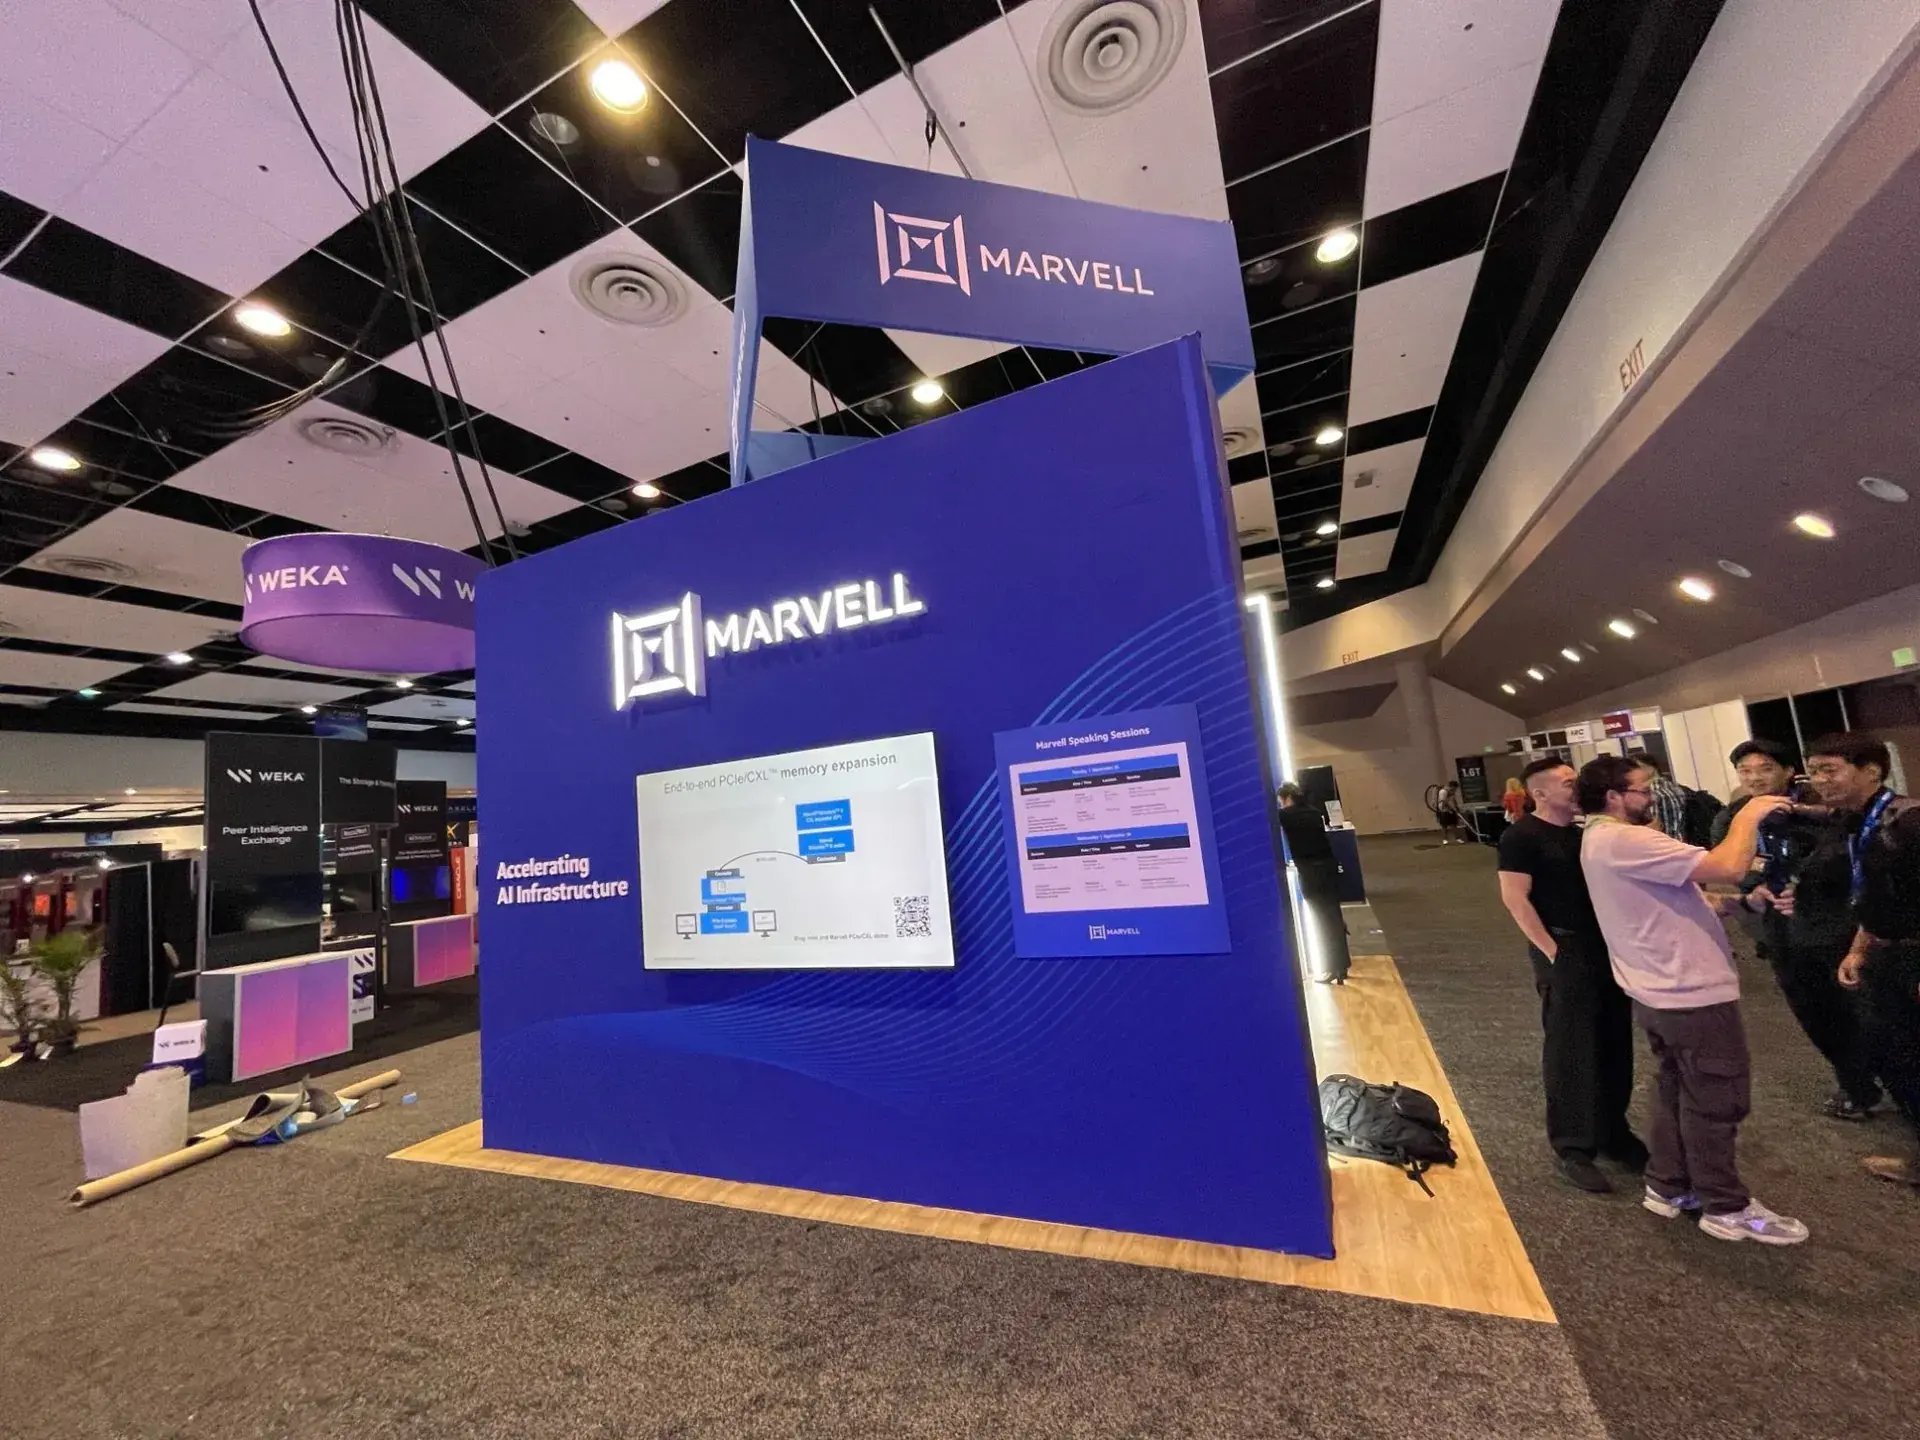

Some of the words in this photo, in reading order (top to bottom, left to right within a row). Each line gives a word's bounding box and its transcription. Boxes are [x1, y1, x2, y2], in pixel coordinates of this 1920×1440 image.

[980, 244, 1155, 297] MARVELL
[1619, 338, 1646, 393] EXIT
[259, 565, 348, 594] WEKA
[707, 573, 926, 658] MARVELL
[1342, 650, 1359, 664] EXIT
[1036, 737, 1067, 750] Marvell
[1068, 732, 1109, 746] Speaking
[1110, 726, 1151, 740] Sessions
[259, 771, 304, 781] WEKA
[338, 776, 352, 785] The
[664, 777, 716, 795] End-to-end
[780, 762, 829, 779] memory
[831, 752, 898, 772] expansion
[222, 826, 248, 836] Peer
[250, 825, 308, 835] Intelligence
[241, 835, 292, 845] Exchange
[496, 853, 590, 880] Accelerating
[497, 885, 514, 905] AI
[516, 879, 630, 904] Infrastructure
[1106, 926, 1141, 936] MARVELL
